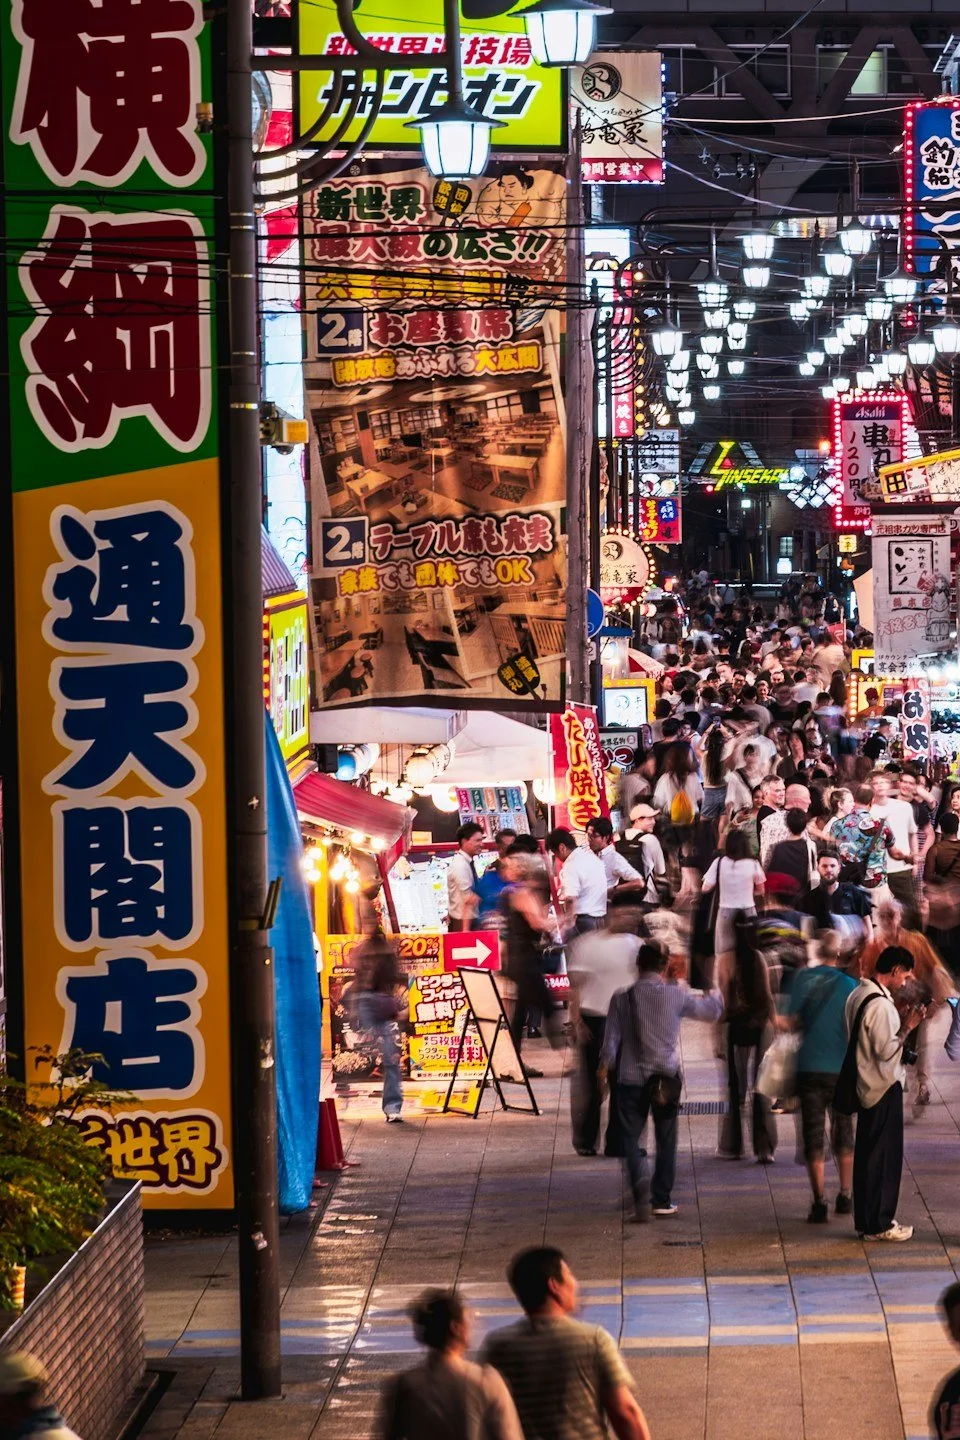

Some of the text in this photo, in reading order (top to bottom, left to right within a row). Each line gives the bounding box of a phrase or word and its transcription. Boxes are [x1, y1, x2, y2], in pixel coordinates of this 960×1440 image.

[921, 136, 956, 188] 釣船
[315, 184, 425, 224] 新世界
[855, 406, 886, 418] Asahi
[371, 514, 553, 559] テーブル席も充実
[337, 559, 533, 597] 家族でも団体でもOK
[560, 710, 601, 830] たい焼き
[42, 500, 207, 1099] 通天閣店
